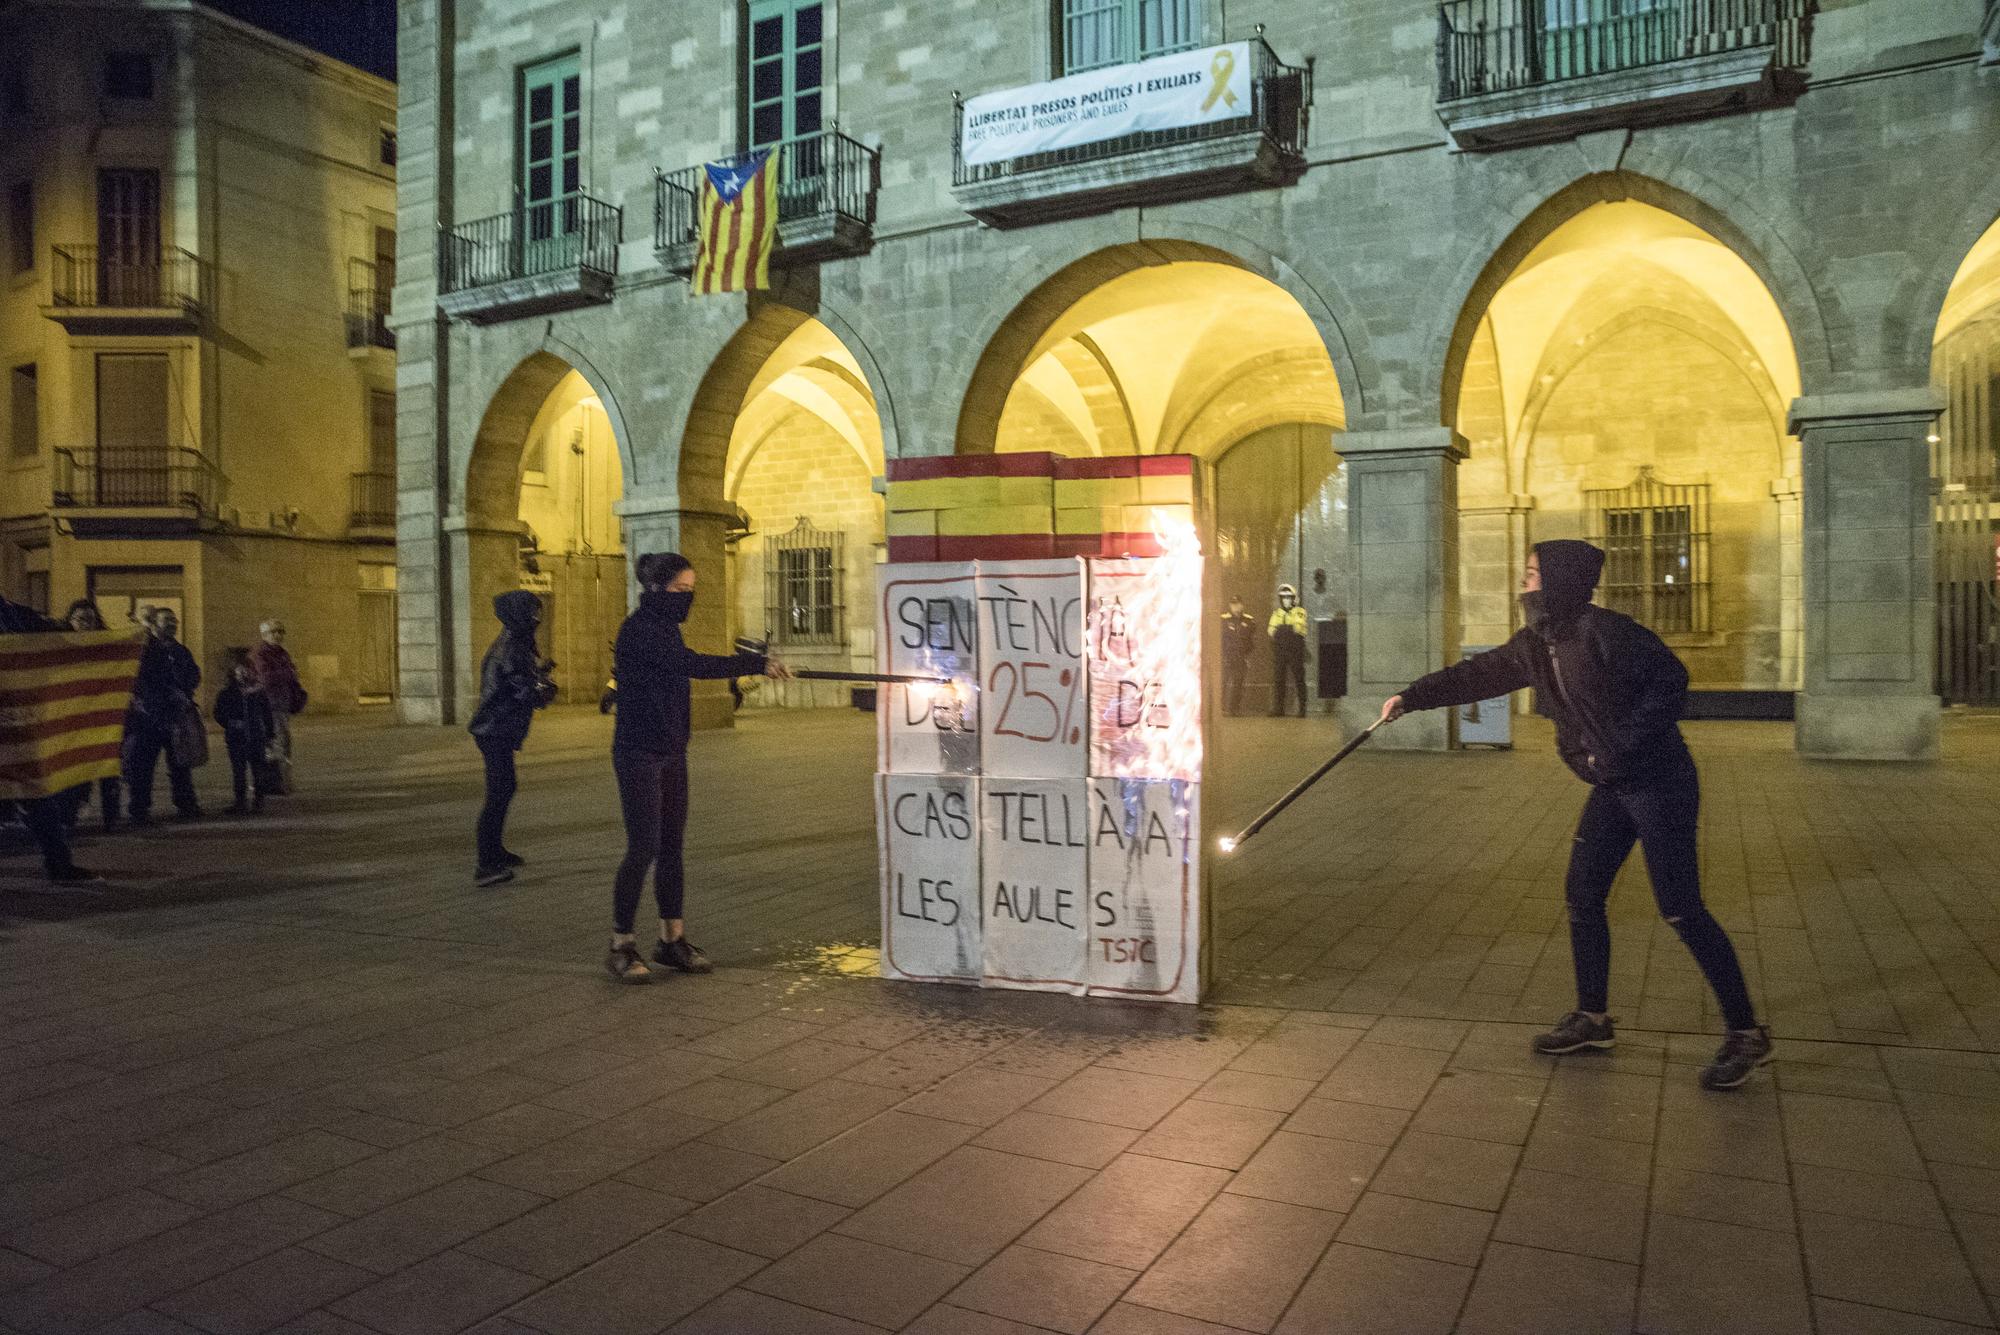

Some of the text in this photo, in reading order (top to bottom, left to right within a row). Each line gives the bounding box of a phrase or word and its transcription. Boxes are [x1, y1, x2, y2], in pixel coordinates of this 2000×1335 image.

[968, 71, 1202, 128] LLIBERTAT PRESOS POLÍTICS I EXILIATS
[1032, 110, 1079, 129] PRISONERS
[1080, 105, 1100, 121] AND
[1102, 101, 1128, 116] EXILES
[989, 661, 1080, 744] 25%
[1118, 680, 1170, 729] DE
[1145, 811, 1173, 857] A
[898, 873, 960, 926] LES
